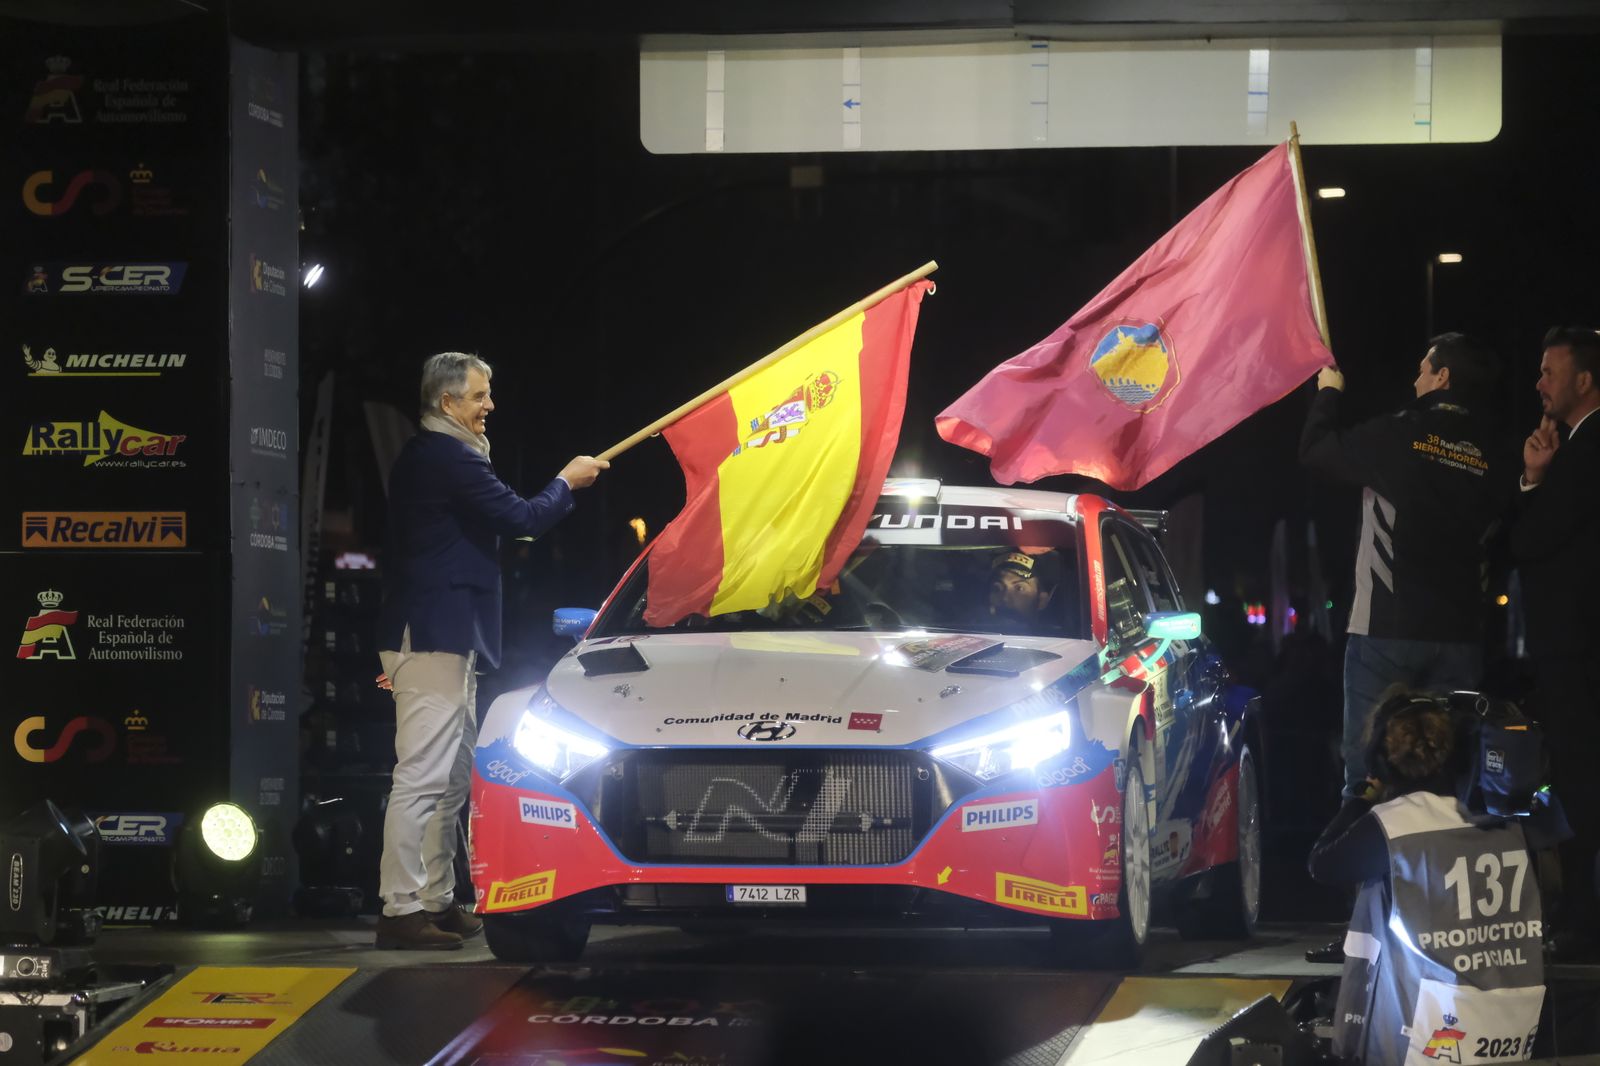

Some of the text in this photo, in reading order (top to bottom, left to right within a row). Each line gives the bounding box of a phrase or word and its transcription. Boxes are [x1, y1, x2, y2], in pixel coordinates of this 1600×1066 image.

[66, 353, 186, 367] MICHELIN
[94, 459, 187, 469] www.rallycar.es
[1413, 441, 1447, 457] SIERRA
[1448, 451, 1488, 469] MORENA
[51, 516, 158, 543] Recalvi
[871, 514, 1023, 530] UNDAI
[87, 614, 185, 628] Real Federación
[99, 630, 173, 647] Española de
[88, 646, 183, 661] Automovilismo
[663, 712, 842, 725] Comunidad de Madrid
[522, 803, 572, 823] PHILIPS
[966, 805, 1034, 826] PHILIPS
[494, 877, 549, 903] PIRELLI
[739, 888, 800, 900] 7412 LZR
[1005, 879, 1078, 909] PIRELLI
[1444, 850, 1529, 920] 137
[1418, 920, 1543, 950] PRODUCTOR
[1454, 948, 1527, 972] OFICIAL
[1474, 1036, 1521, 1058] 2023
